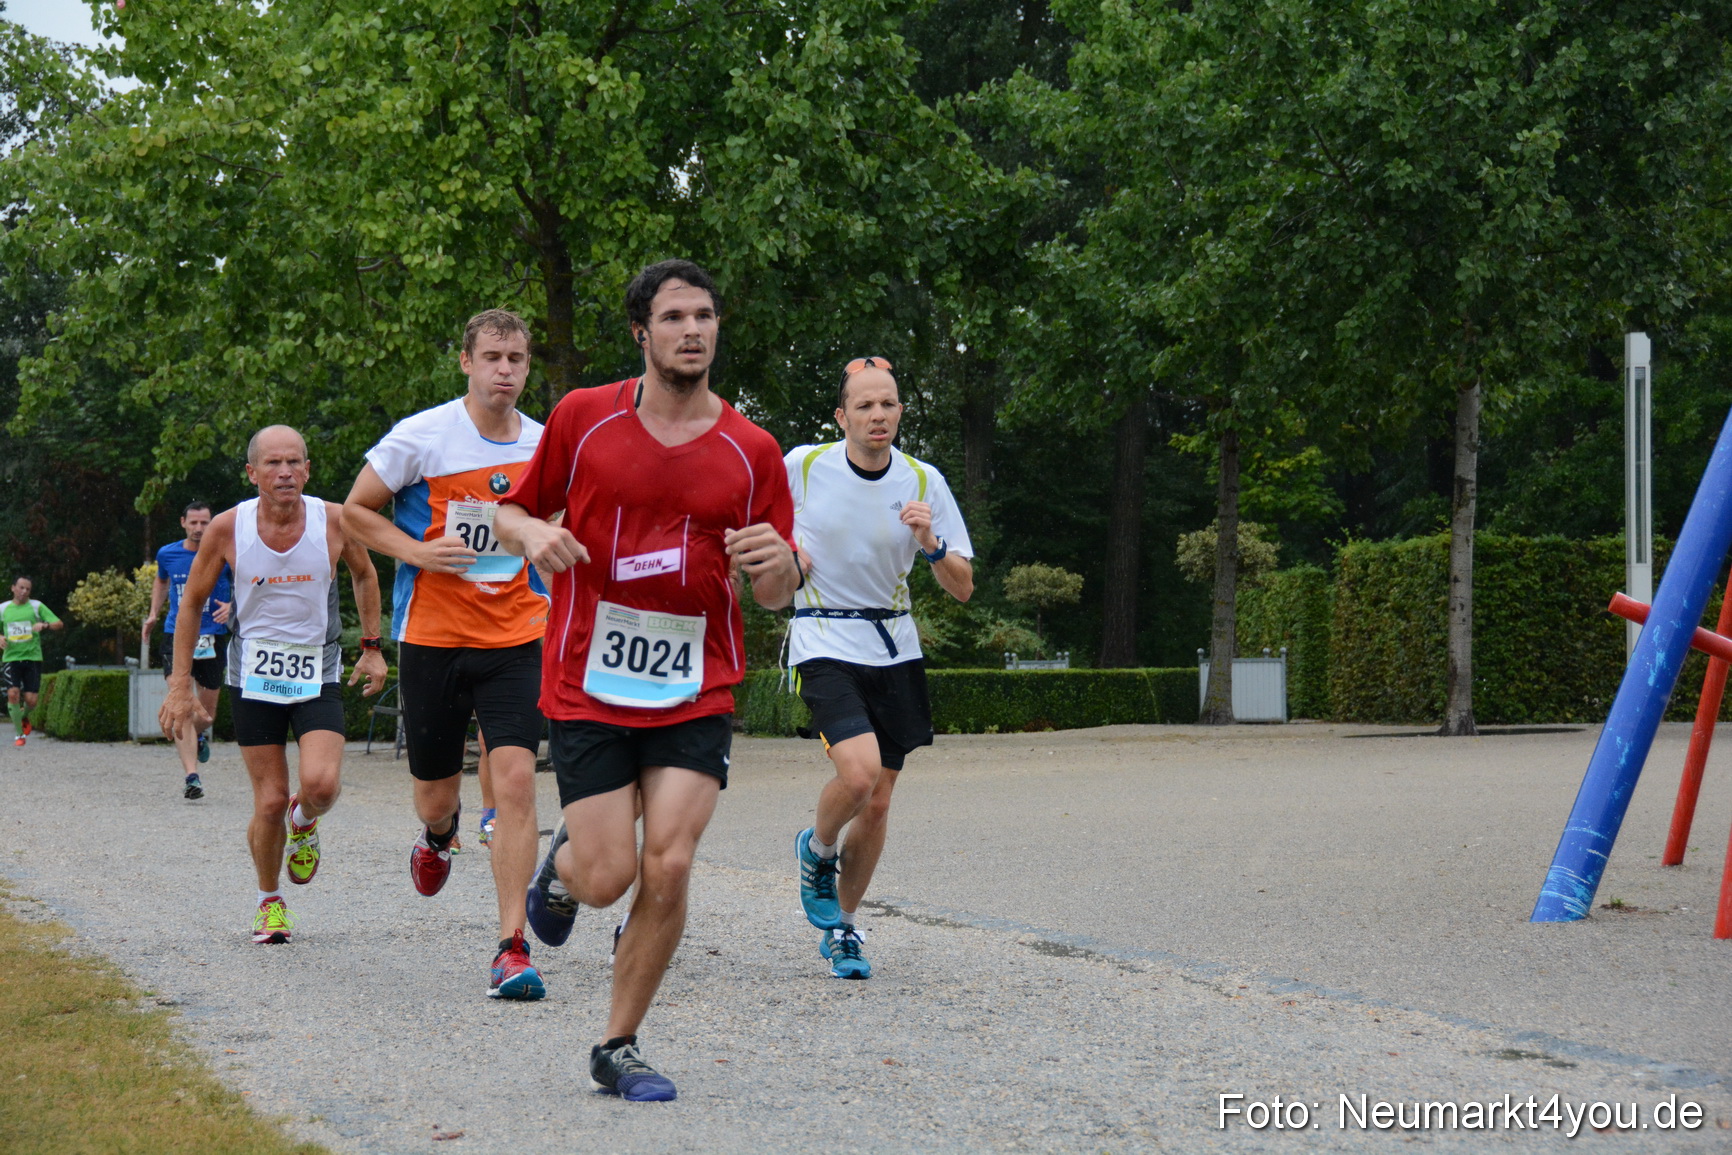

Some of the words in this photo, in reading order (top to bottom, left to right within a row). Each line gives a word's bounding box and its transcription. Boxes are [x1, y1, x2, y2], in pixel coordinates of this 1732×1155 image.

[634, 558, 663, 572] DEHN
[268, 574, 316, 585] KLEBL
[606, 615, 640, 628] NeuerMarkt
[647, 615, 697, 633] BOCK
[602, 630, 693, 679] 3024
[254, 649, 315, 680] 2535
[263, 681, 303, 695] Berthold
